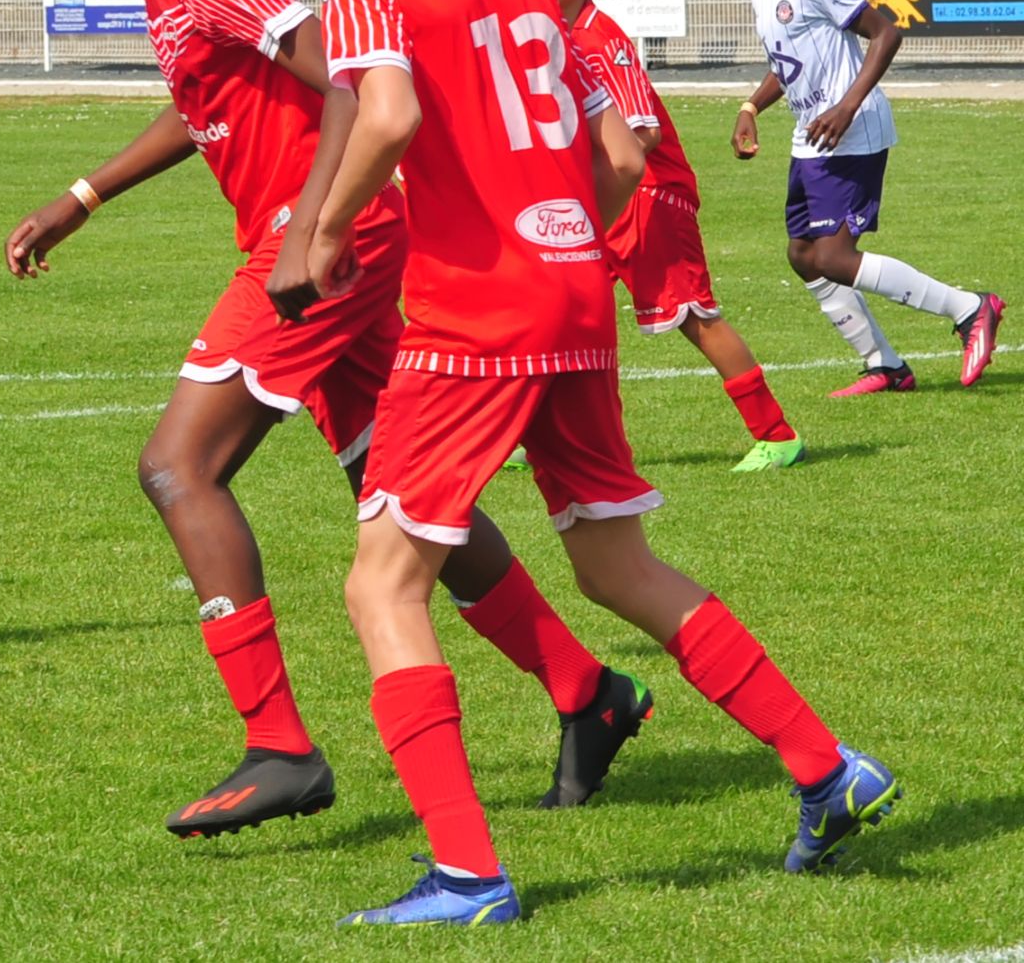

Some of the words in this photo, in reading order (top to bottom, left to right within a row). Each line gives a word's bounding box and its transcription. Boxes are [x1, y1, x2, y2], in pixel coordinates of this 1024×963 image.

[469, 11, 579, 152] 13
[536, 208, 589, 237] Ford
[539, 249, 603, 263] VALENCIENNES
